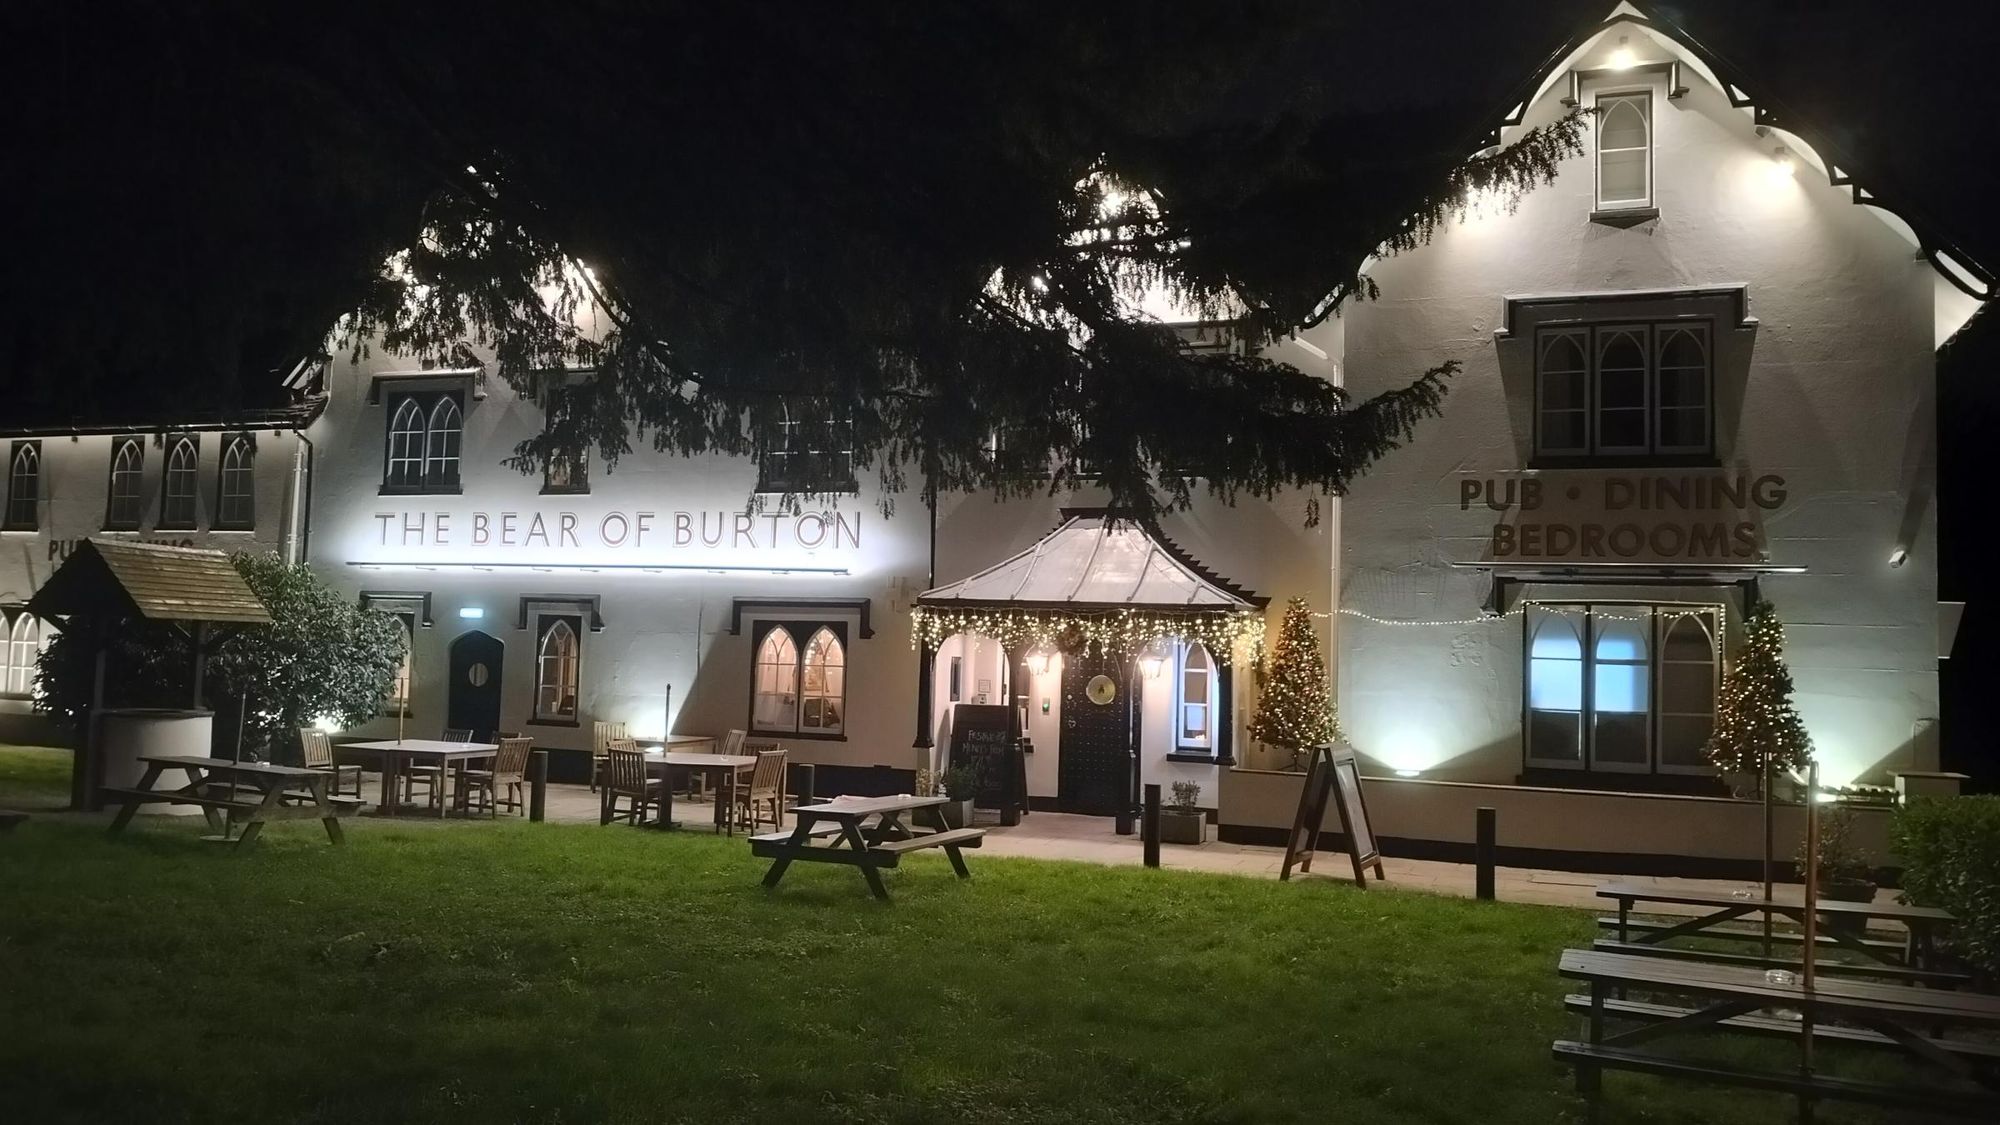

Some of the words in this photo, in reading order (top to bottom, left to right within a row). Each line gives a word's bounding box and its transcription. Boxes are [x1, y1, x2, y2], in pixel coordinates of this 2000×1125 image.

[1460, 478, 1543, 511] PUB
[1604, 474, 1788, 510] DINING
[374, 512, 450, 546] THE
[471, 512, 582, 547] BEAR
[599, 511, 655, 548] OF
[672, 511, 861, 549] BURTON
[1493, 521, 1761, 559] BEDROOMS
[48, 539, 85, 561] PU
